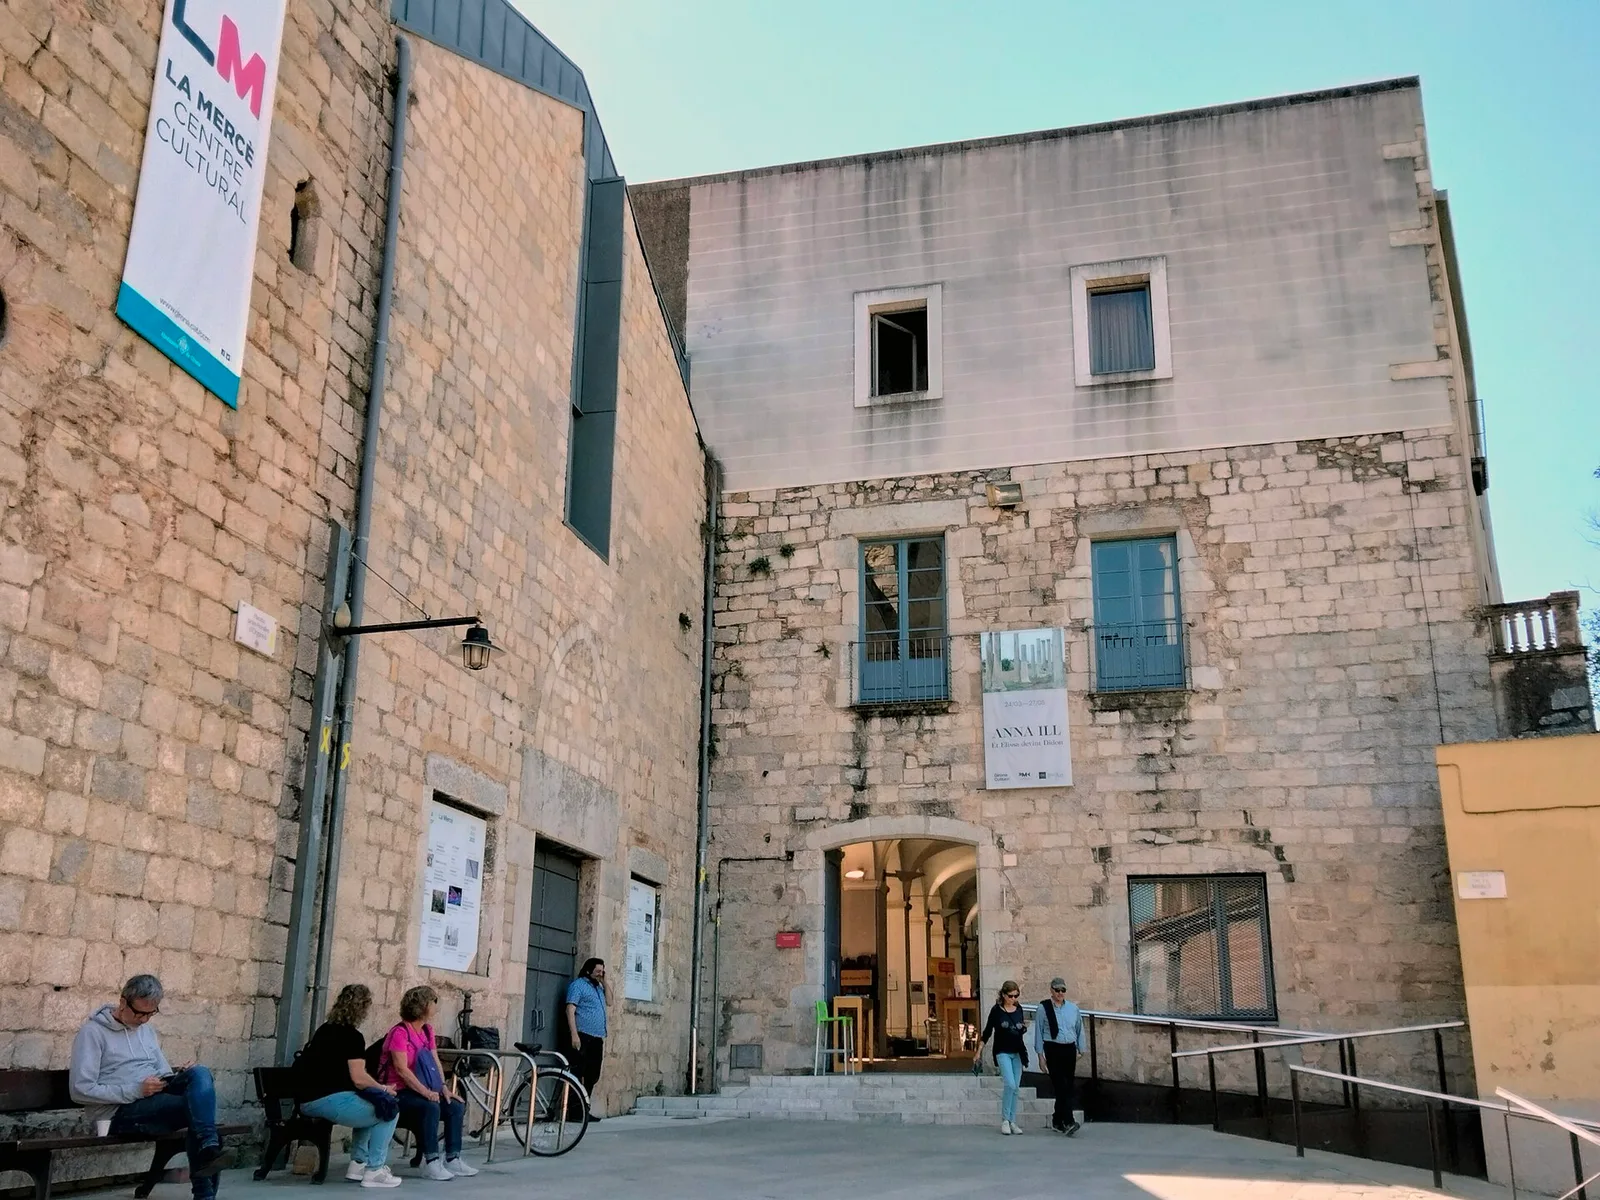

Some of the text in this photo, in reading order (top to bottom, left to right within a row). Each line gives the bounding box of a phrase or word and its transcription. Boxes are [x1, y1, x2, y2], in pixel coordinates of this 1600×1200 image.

[165, 58, 255, 169] LA MERCÈ
[173, 101, 244, 186] CENTRE
[156, 117, 247, 225] CULTURAL
[992, 724, 1062, 739] ANNA ILL
